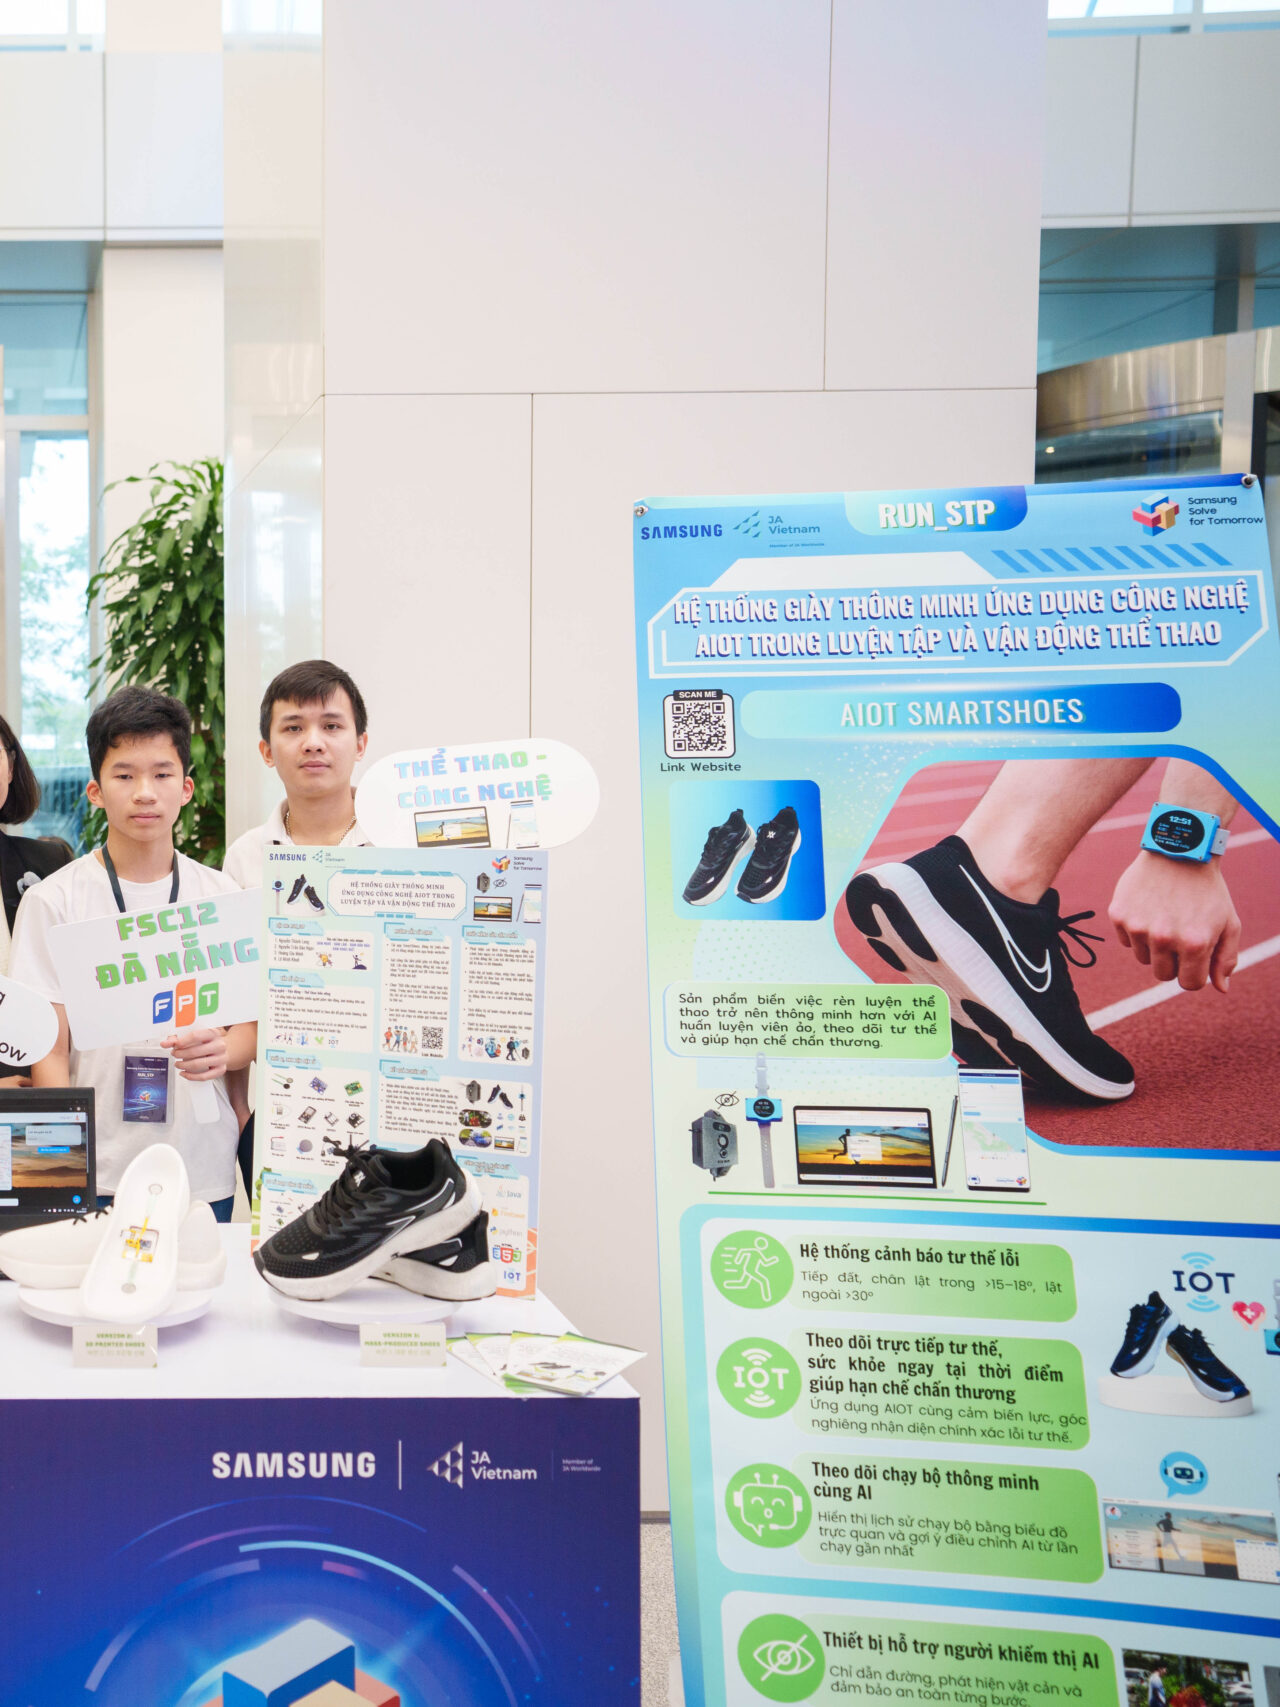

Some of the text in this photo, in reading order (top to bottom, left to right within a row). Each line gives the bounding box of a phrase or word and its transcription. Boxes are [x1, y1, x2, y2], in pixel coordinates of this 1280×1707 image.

[1187, 496, 1237, 506] Samsung
[878, 499, 996, 531] RUN_STP
[1188, 506, 1217, 515] Solve
[768, 515, 783, 524] JA
[1189, 515, 1263, 526] for Tomorrow
[641, 524, 723, 540] SAMSUNG
[769, 525, 820, 534] Vietnam
[674, 578, 1249, 629] HỆ THỐNG GIÀY THÔNG MINH ỨNG DỤNG CÔNG NGHỆ
[695, 613, 1222, 659] AIOT TRONG LUYỆN TẬP VÀ VẬN ĐỘNG THỂ THAO
[679, 690, 717, 699] SCAN ME
[840, 698, 1086, 728] AIOT SMARTSHOES
[394, 748, 448, 779] THỂ
[454, 751, 529, 773] THAO
[660, 761, 741, 772] Link Website
[397, 773, 553, 809] CÔNG NGHỆ
[269, 853, 307, 861] SAMSUNG
[116, 902, 219, 941] FSC12
[95, 952, 147, 989] ĐÀ
[155, 932, 260, 979] NẴNG
[679, 993, 936, 1009] Sản phẩm biến việc rèn luyện thể
[679, 1007, 937, 1021] thao trở nên thông minh hơn với AI
[679, 1019, 938, 1035] huấn luyện viên ảo, theo dõi tư thế
[680, 1033, 883, 1049] và giúp hạn chế chấn thương.
[799, 1243, 1020, 1267] Hệ thống cảnh báo tư thế lỗi
[1172, 1270, 1235, 1294] IOT
[733, 1366, 790, 1390] IOT
[211, 1451, 376, 1479] SAMSUNG
[470, 1451, 491, 1465] JA
[471, 1466, 537, 1481] Vietnam
